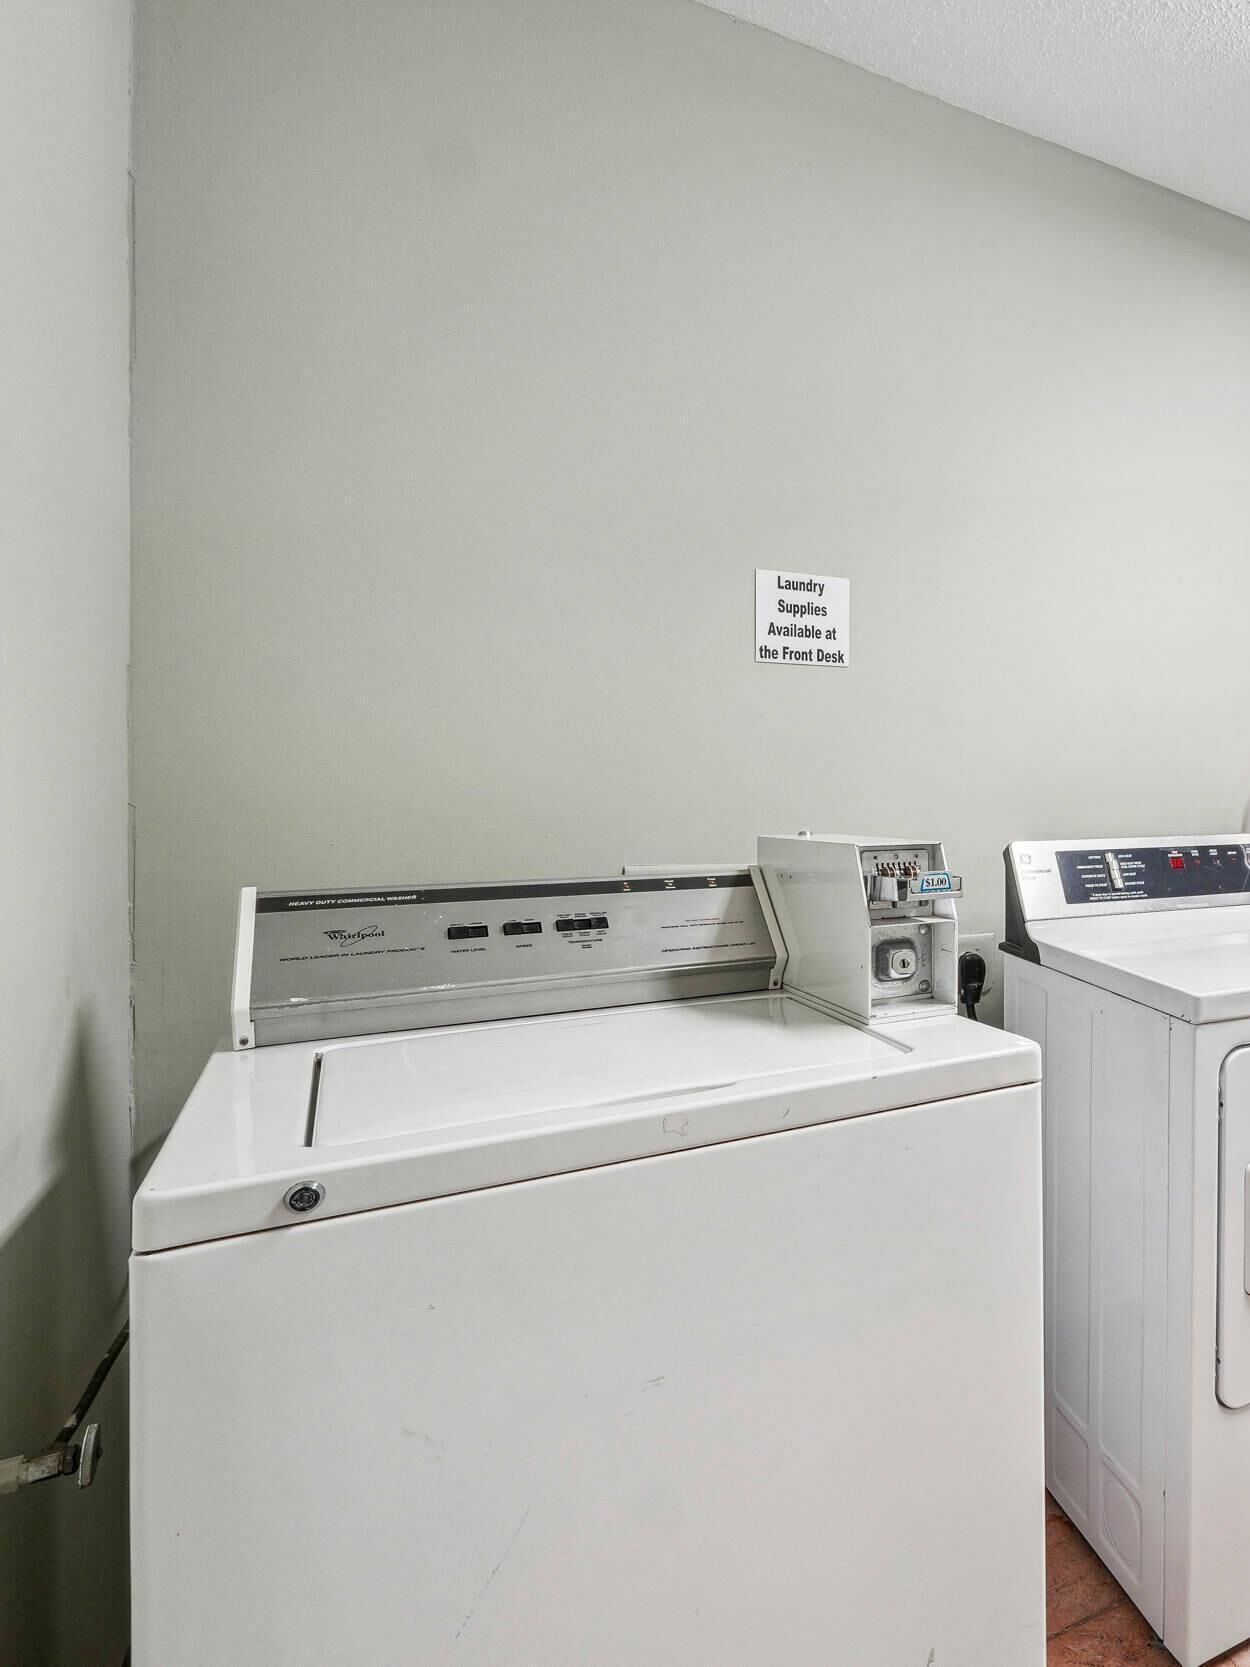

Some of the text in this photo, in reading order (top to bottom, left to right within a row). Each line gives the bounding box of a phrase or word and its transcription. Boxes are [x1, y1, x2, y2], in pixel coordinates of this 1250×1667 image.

[777, 575, 825, 597] Laundry
[777, 598, 828, 618] Supplies
[767, 621, 837, 640] Available at
[759, 644, 845, 664] the Front Desk
[925, 877, 947, 888] $1.00
[337, 896, 386, 904] COMMERCIAL
[386, 894, 417, 902] WASHER
[325, 928, 385, 942] Whirlpool
[309, 952, 339, 960] LEADER
[350, 949, 385, 957] LAUNDRY
